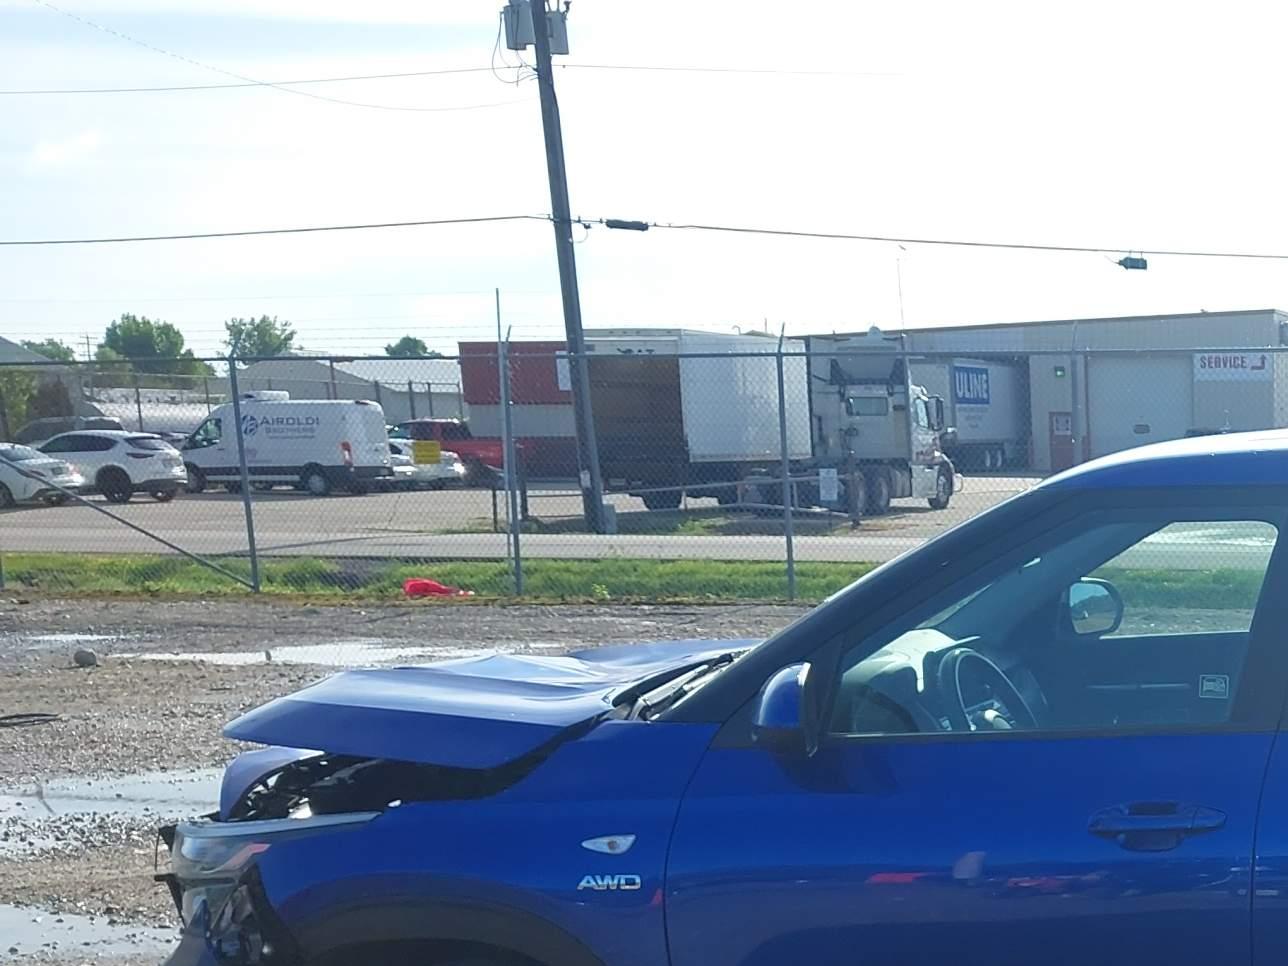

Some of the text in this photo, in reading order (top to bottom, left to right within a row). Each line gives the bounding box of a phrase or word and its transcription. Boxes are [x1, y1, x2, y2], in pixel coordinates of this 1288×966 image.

[1200, 355, 1248, 369] SERVICE
[955, 371, 988, 399] ULINE
[260, 416, 320, 425] AIROLDI
[577, 874, 641, 890] AWD
